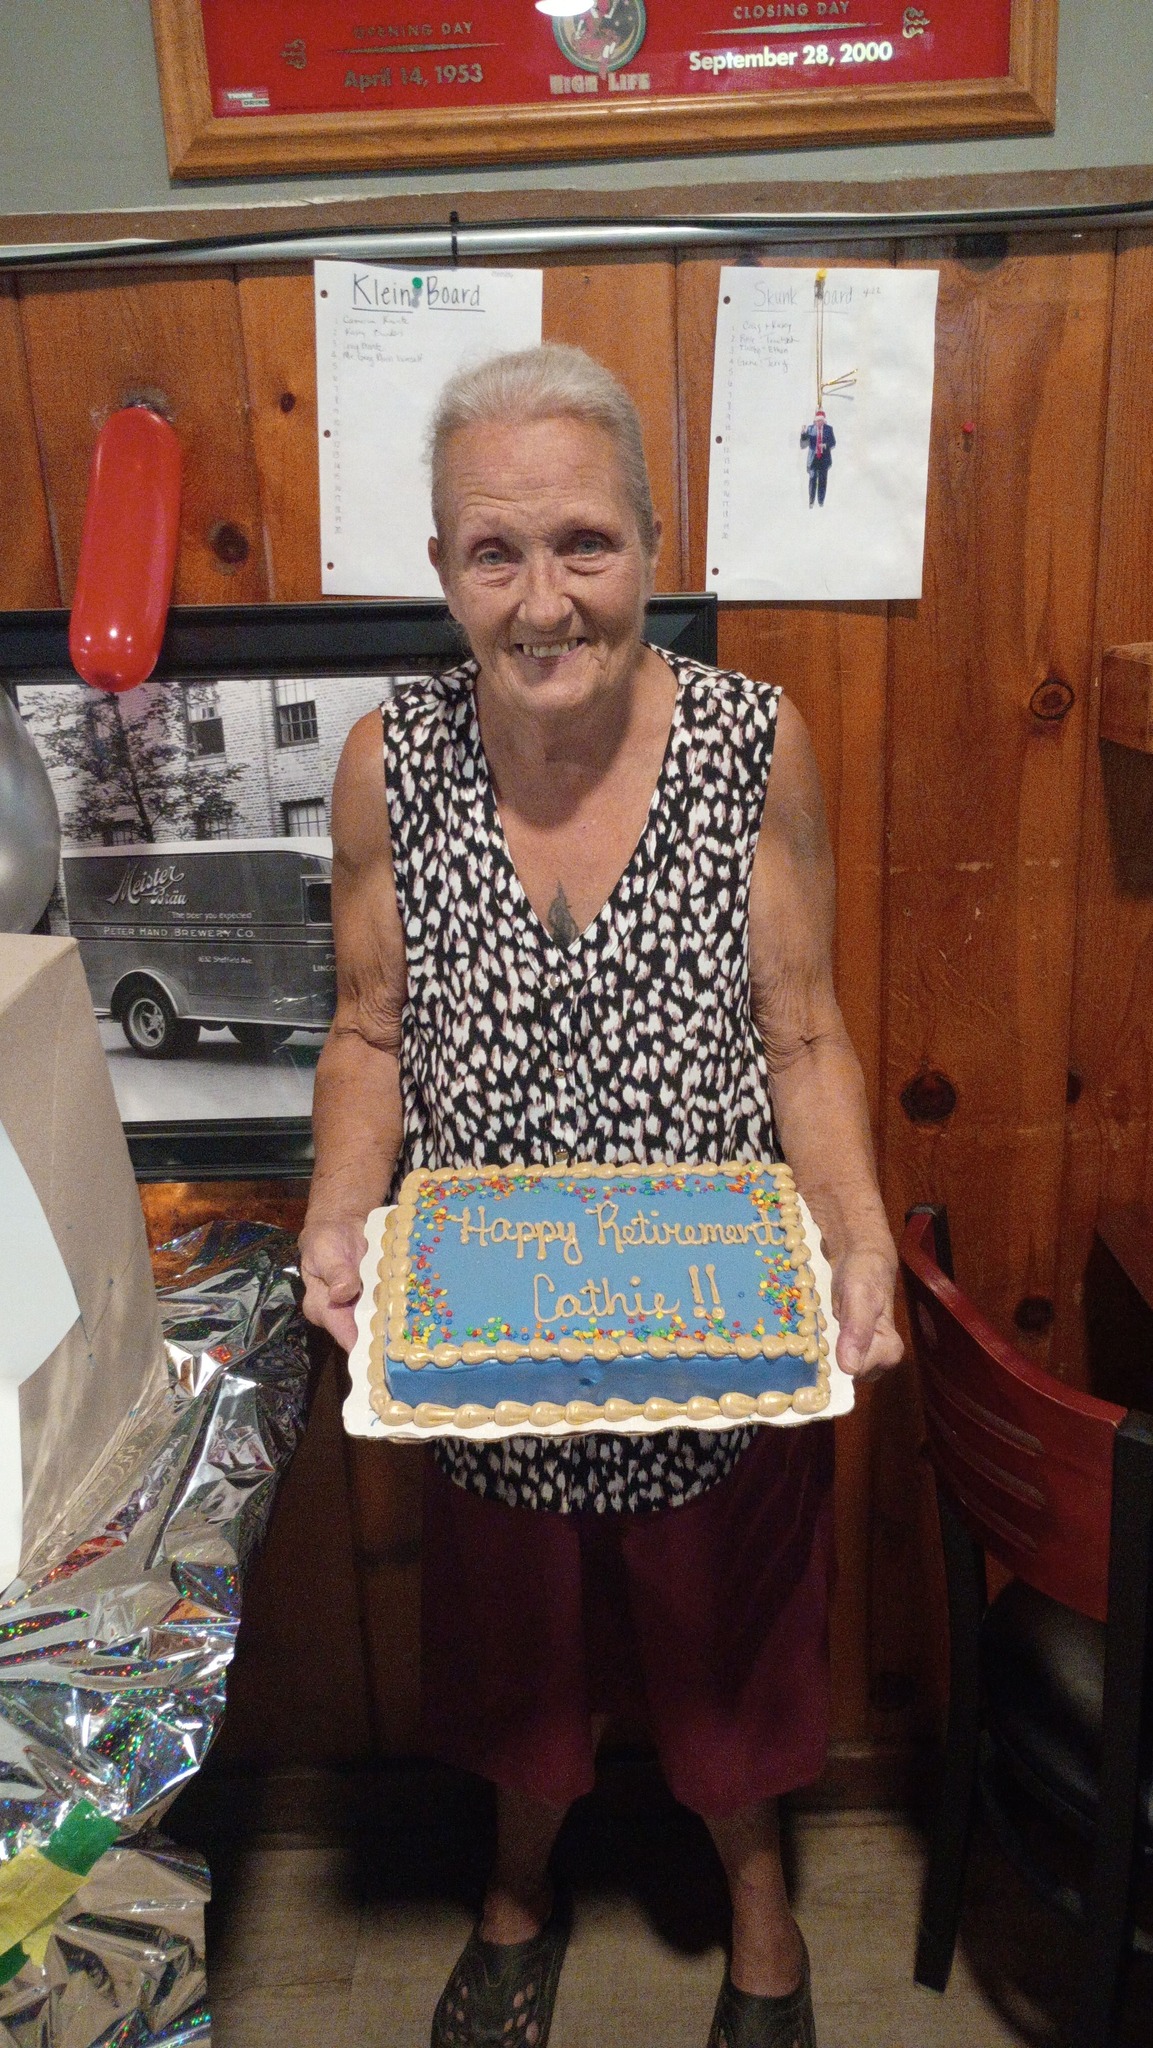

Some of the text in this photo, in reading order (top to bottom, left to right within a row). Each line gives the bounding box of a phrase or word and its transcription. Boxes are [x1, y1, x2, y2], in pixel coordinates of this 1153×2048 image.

[732, 1, 851, 20] CLOSING DAY
[441, 21, 473, 35] DAY
[689, 41, 893, 74] September 28, 2000
[344, 62, 484, 93] April 14, 1953
[352, 272, 481, 307] Klein Board
[753, 281, 799, 307] Skunk
[813, 284, 853, 308] oard
[106, 861, 185, 905] Meister
[149, 886, 188, 905] Bräu
[203, 912, 218, 922] you
[103, 927, 135, 936] PETER
[139, 928, 168, 937] HAND
[174, 928, 232, 938] BREWERY
[449, 1201, 787, 1266] Happy Retirement
[532, 1273, 680, 1323] Cathie
